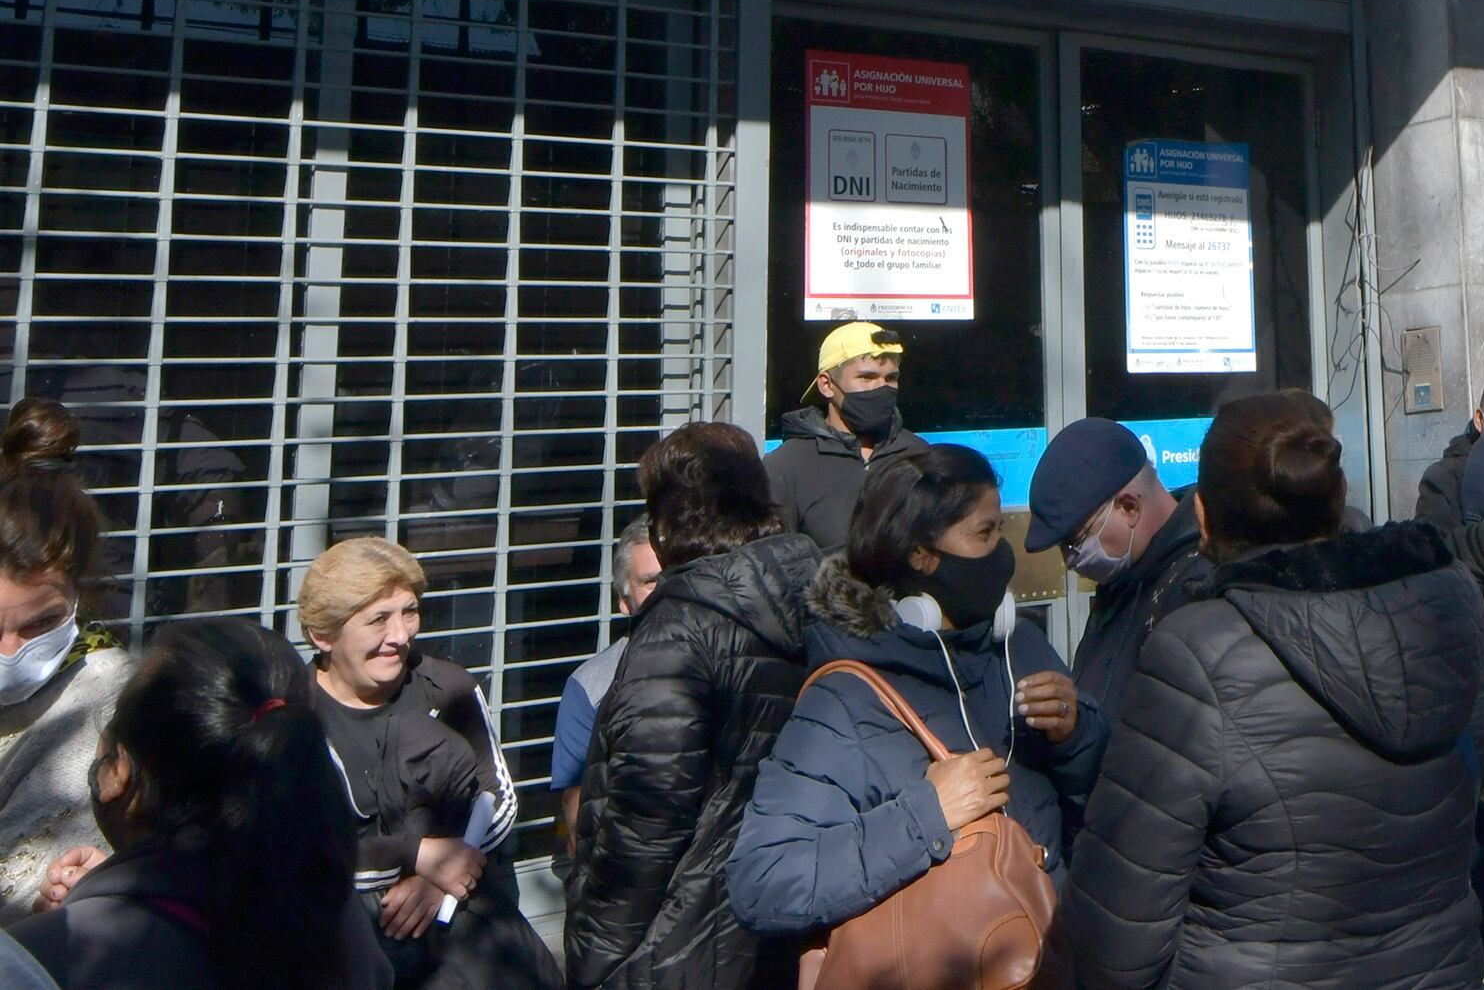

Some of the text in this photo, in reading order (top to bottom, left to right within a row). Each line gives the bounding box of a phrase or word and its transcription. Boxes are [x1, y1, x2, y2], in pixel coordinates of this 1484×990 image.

[853, 69, 964, 88] ASIGNACIÓN UNIVERSAL
[853, 82, 897, 94] POR HIJO
[1206, 151, 1245, 163] UNIVERSAL
[1160, 159, 1193, 170] POR HIJO
[891, 166, 942, 179] Partidas de
[833, 175, 871, 197] DNI
[891, 180, 942, 192] Nacimiento
[833, 222, 842, 231] Es
[843, 222, 898, 233] indispensable
[899, 224, 924, 234] contar
[926, 226, 940, 234] con
[836, 234, 950, 246] DNI y partidas de nacimiento
[1165, 239, 1197, 252] Mensaje
[1198, 240, 1205, 250] al
[840, 246, 888, 258] (originales
[890, 249, 895, 259] y
[844, 259, 854, 268] de
[855, 260, 875, 269] todo
[877, 259, 885, 268] el
[887, 261, 910, 271] grupo
